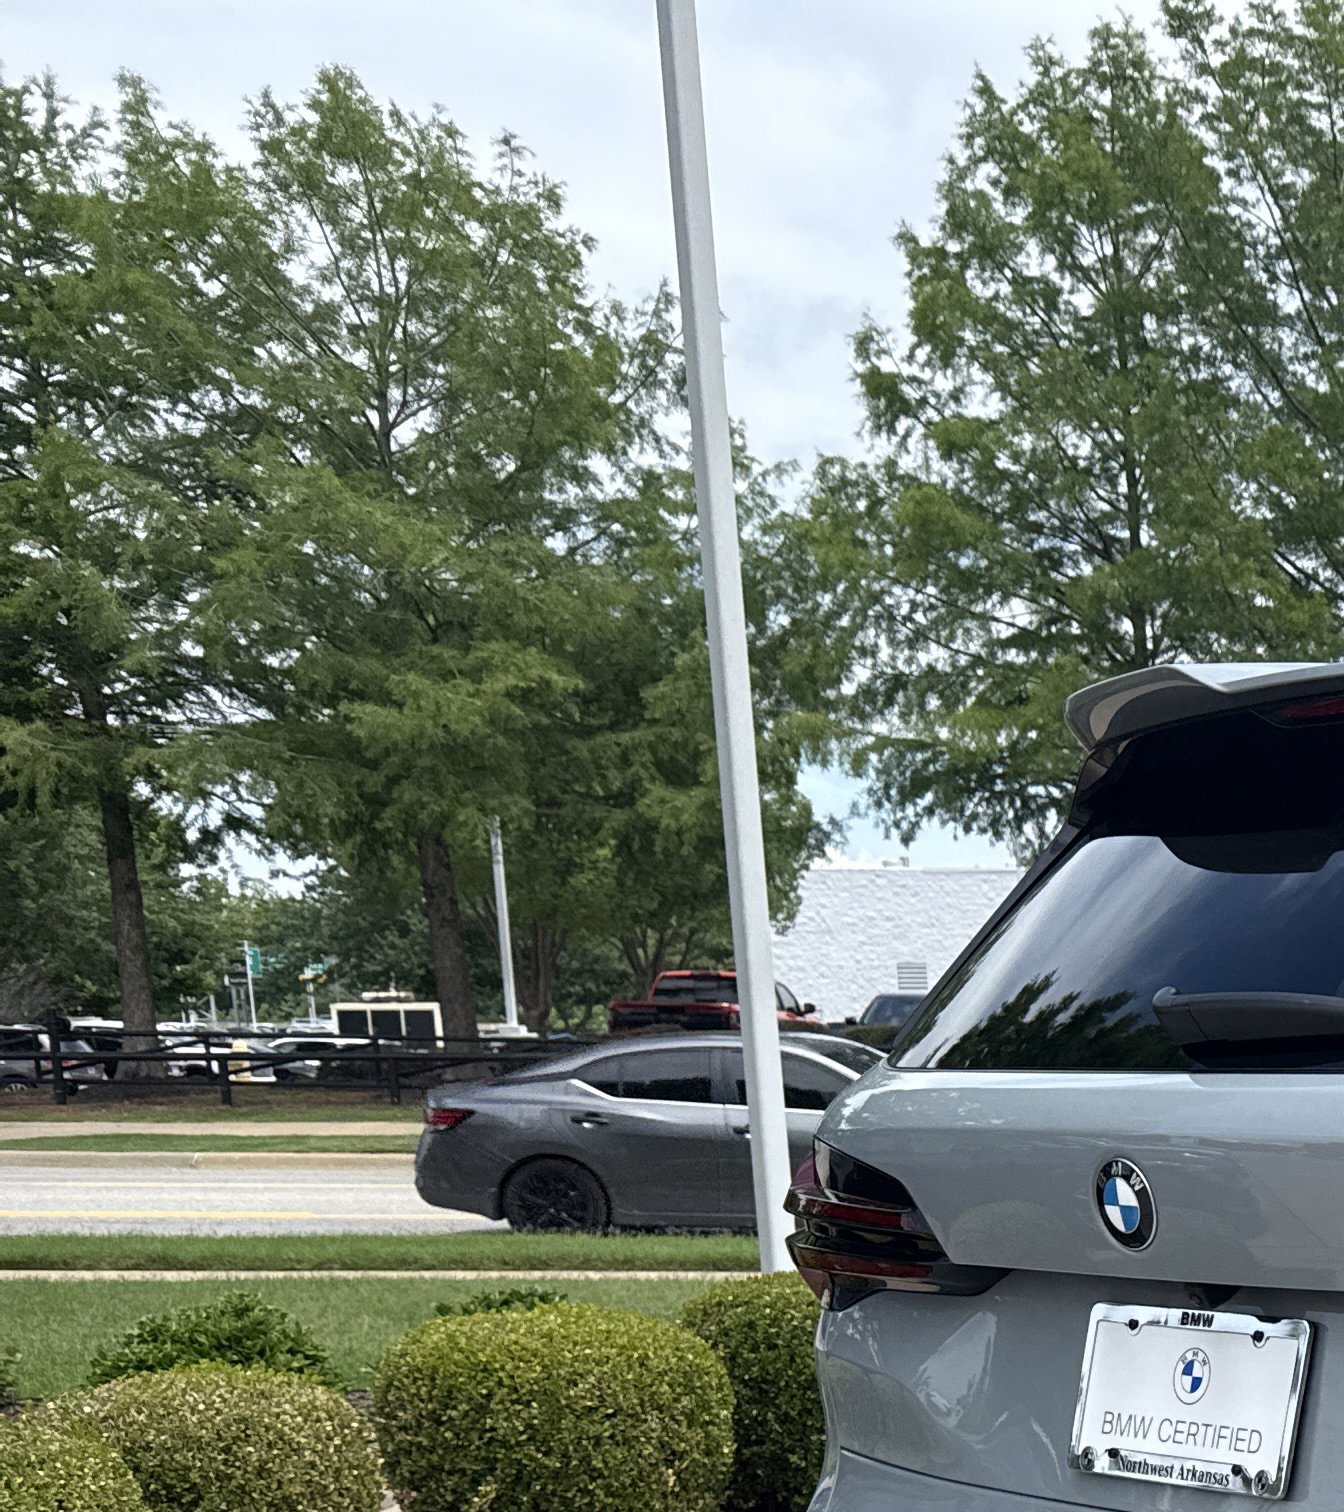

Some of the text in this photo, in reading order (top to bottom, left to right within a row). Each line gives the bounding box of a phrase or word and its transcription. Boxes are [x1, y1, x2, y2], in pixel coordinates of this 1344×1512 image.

[1098, 1162, 1145, 1191] BMW
[1180, 1311, 1214, 1328] BMW
[1180, 1350, 1208, 1367] BMW
[1101, 1411, 1263, 1454] BMW CERTIFIED
[1118, 1455, 1230, 1487] Northwest Arkansas
